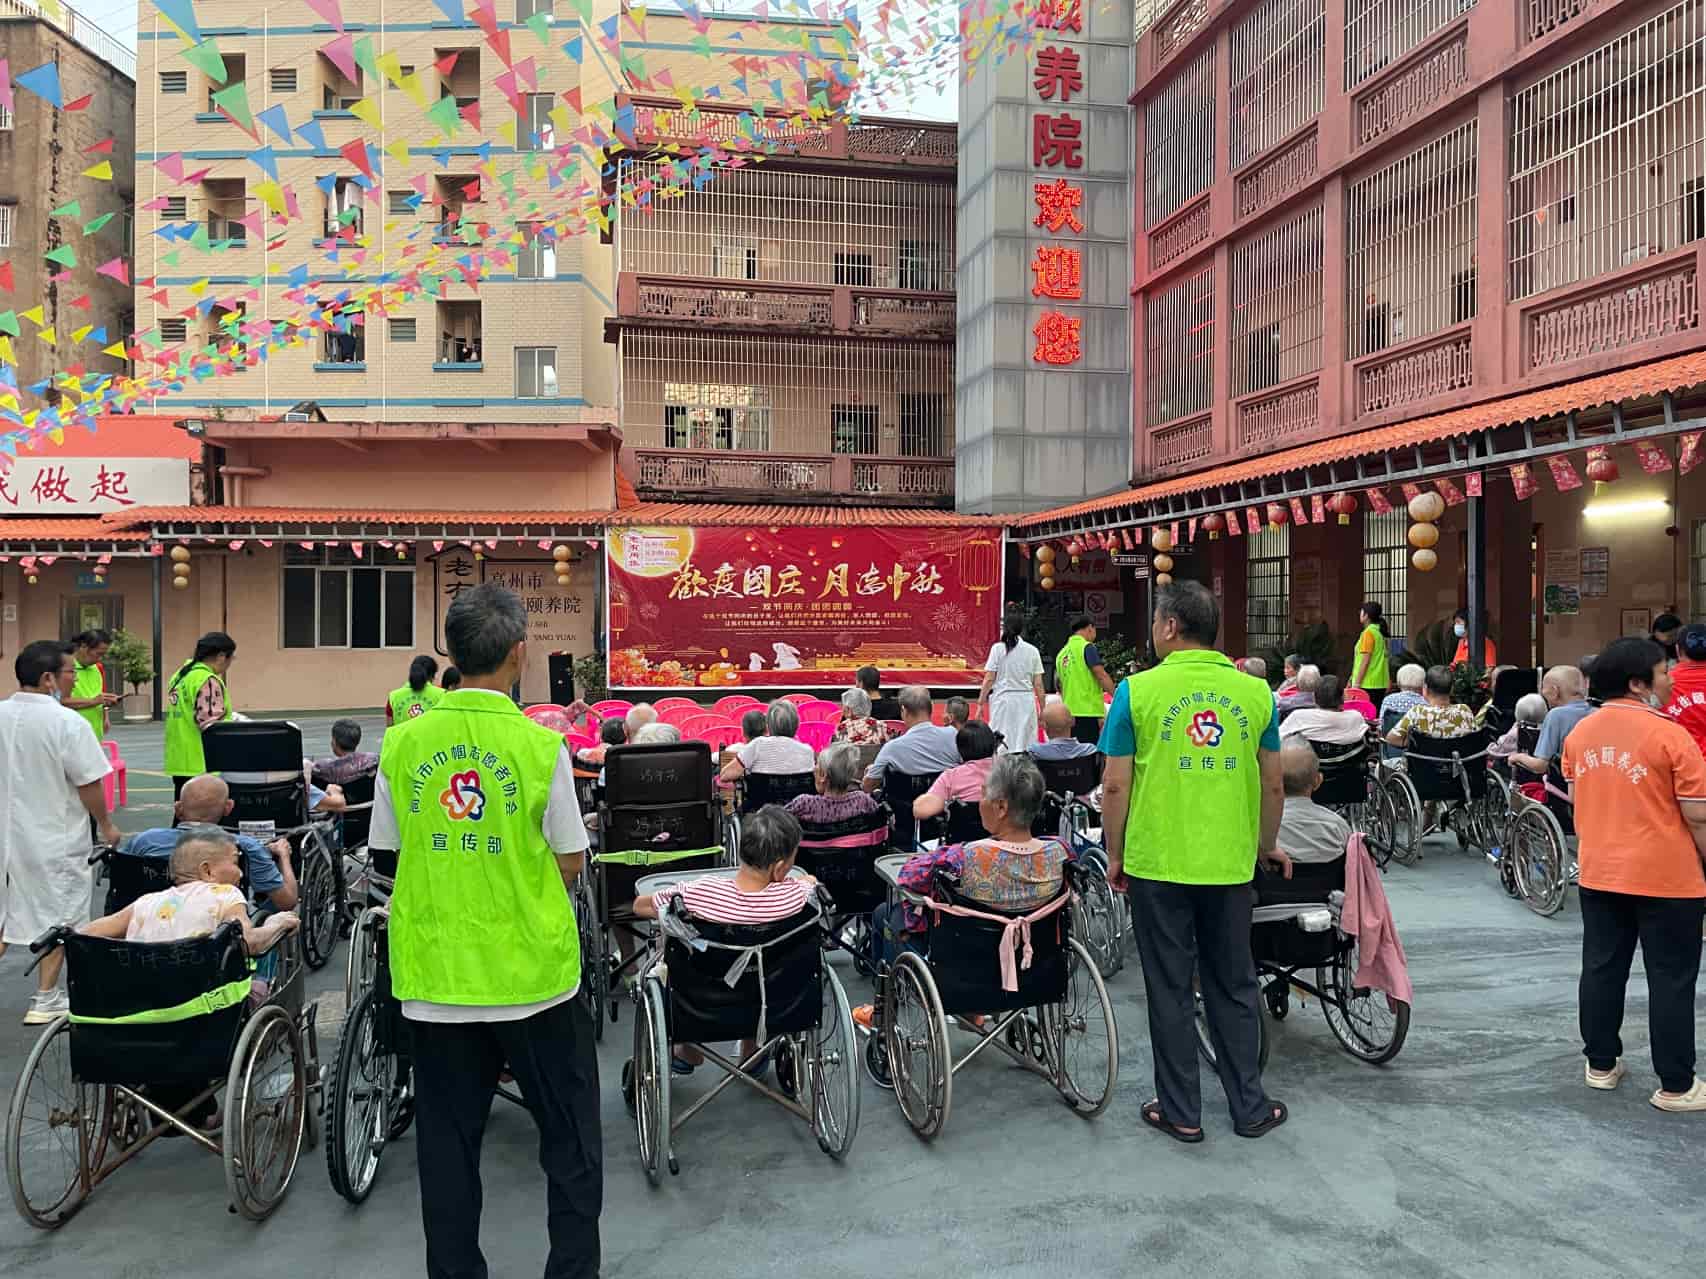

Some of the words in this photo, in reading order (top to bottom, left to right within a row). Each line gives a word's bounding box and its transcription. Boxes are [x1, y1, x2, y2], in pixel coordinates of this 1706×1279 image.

[521, 595, 584, 614] 颐养院
[1179, 756, 1237, 770] 宣传部
[432, 833, 502, 855] 宣传部
